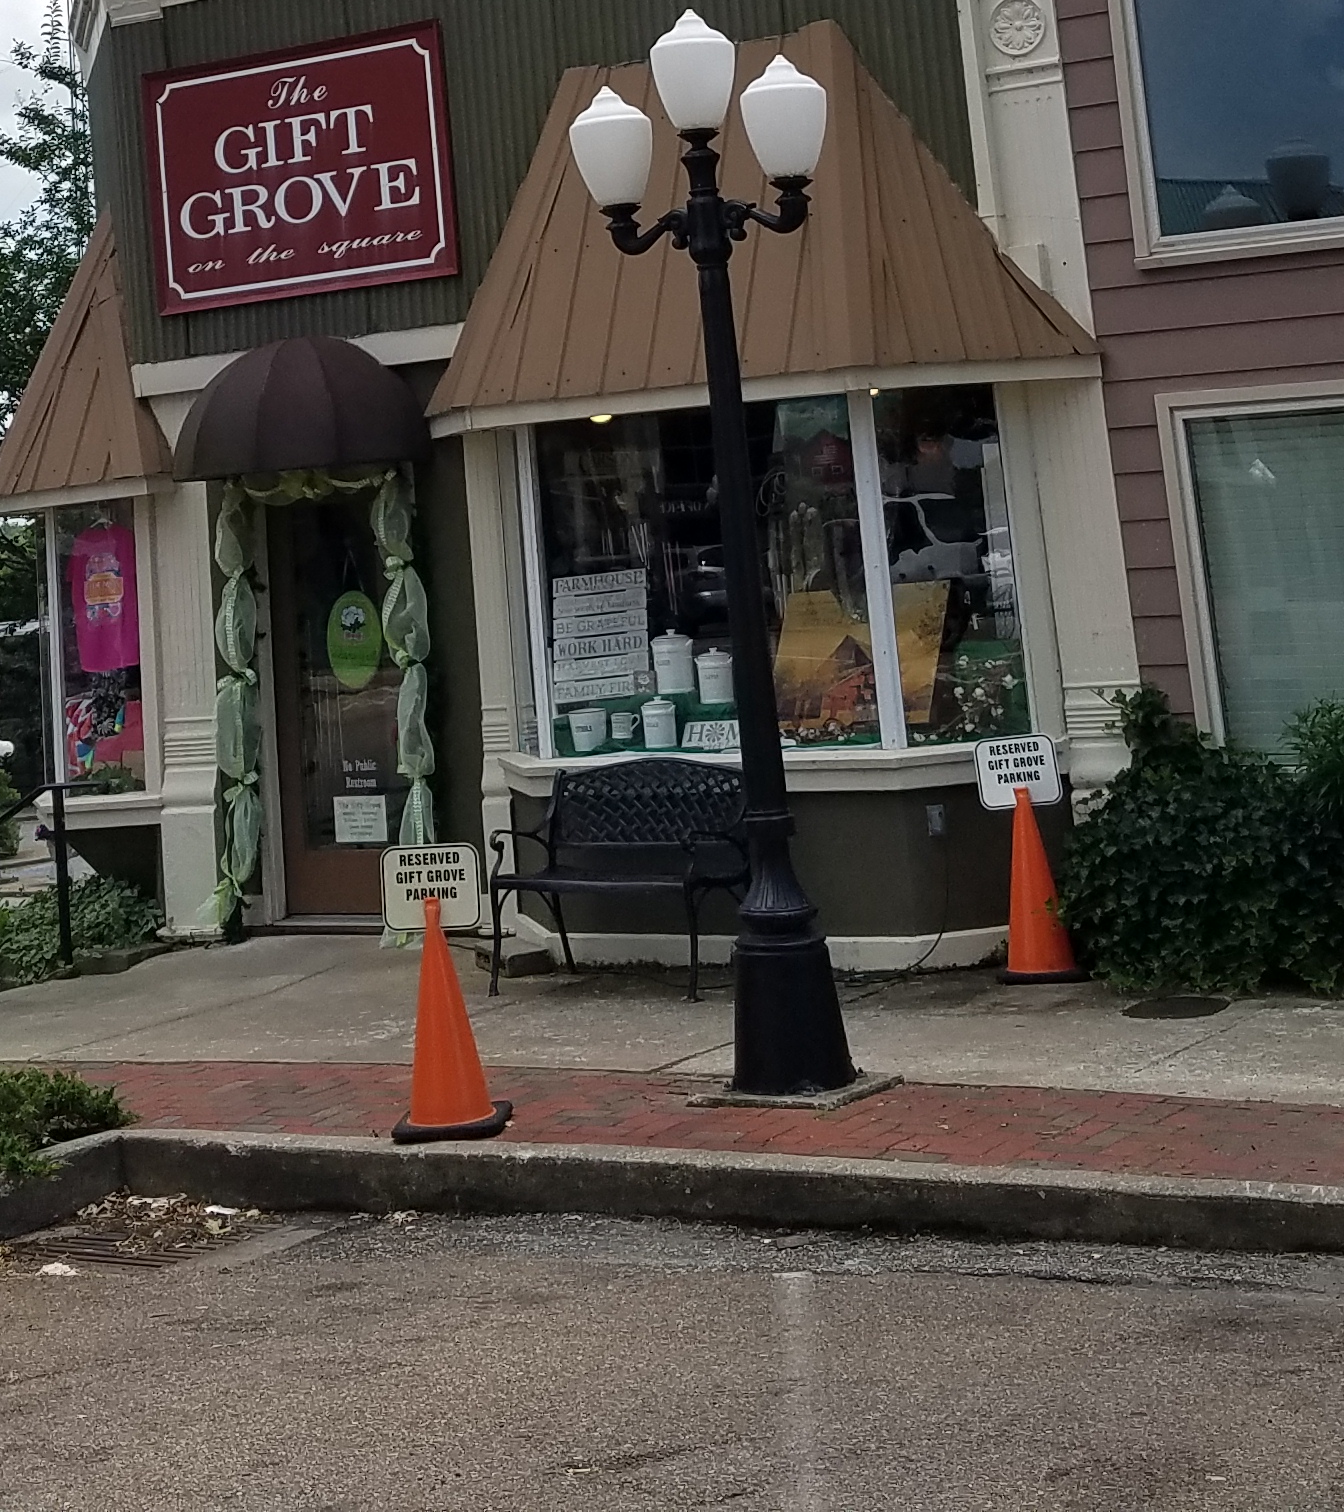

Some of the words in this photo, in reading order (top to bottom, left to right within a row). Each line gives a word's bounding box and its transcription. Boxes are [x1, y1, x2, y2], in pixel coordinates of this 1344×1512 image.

[267, 76, 328, 109] The
[214, 104, 374, 174] GIFT
[180, 158, 420, 239] GROVE
[187, 258, 225, 274] on
[246, 244, 296, 266] the
[317, 229, 423, 259] square
[555, 570, 644, 593] FARMHOUSE
[556, 622, 573, 634] BE
[557, 640, 597, 657] WORK
[602, 636, 643, 652] HARD
[610, 681, 634, 694] FIR
[989, 741, 1039, 756] RESERVED
[988, 759, 1009, 771] GIFT
[1013, 755, 1045, 768] GROVE
[997, 771, 1041, 784] PARKING
[399, 852, 460, 867] RESERVED
[396, 871, 423, 884] GIFT
[427, 869, 466, 882] GROVE
[406, 886, 457, 901] PARKING
